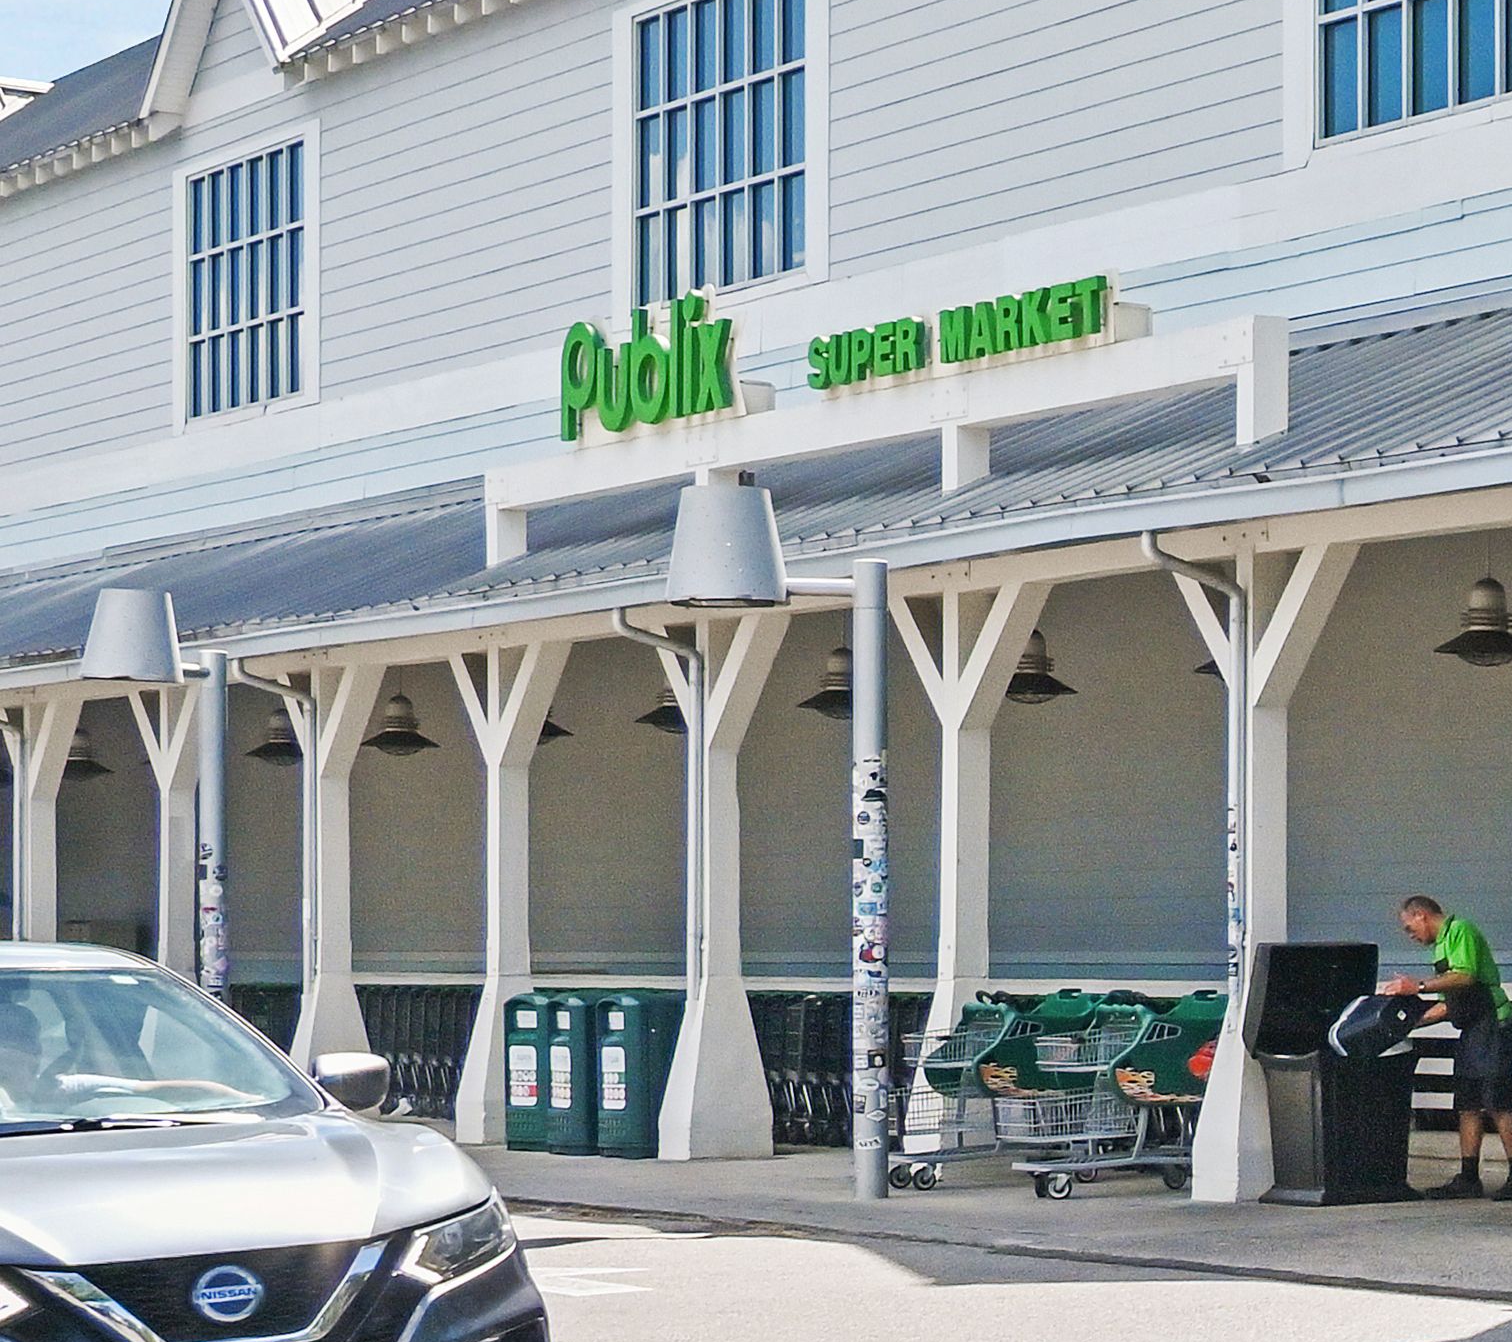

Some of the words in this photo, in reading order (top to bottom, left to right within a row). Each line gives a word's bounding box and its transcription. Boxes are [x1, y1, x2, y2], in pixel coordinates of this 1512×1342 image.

[561, 288, 732, 441] Publix
[807, 316, 925, 390] SUPER
[939, 275, 1107, 364] MARKET
[200, 1287, 257, 1301] NISSAN
